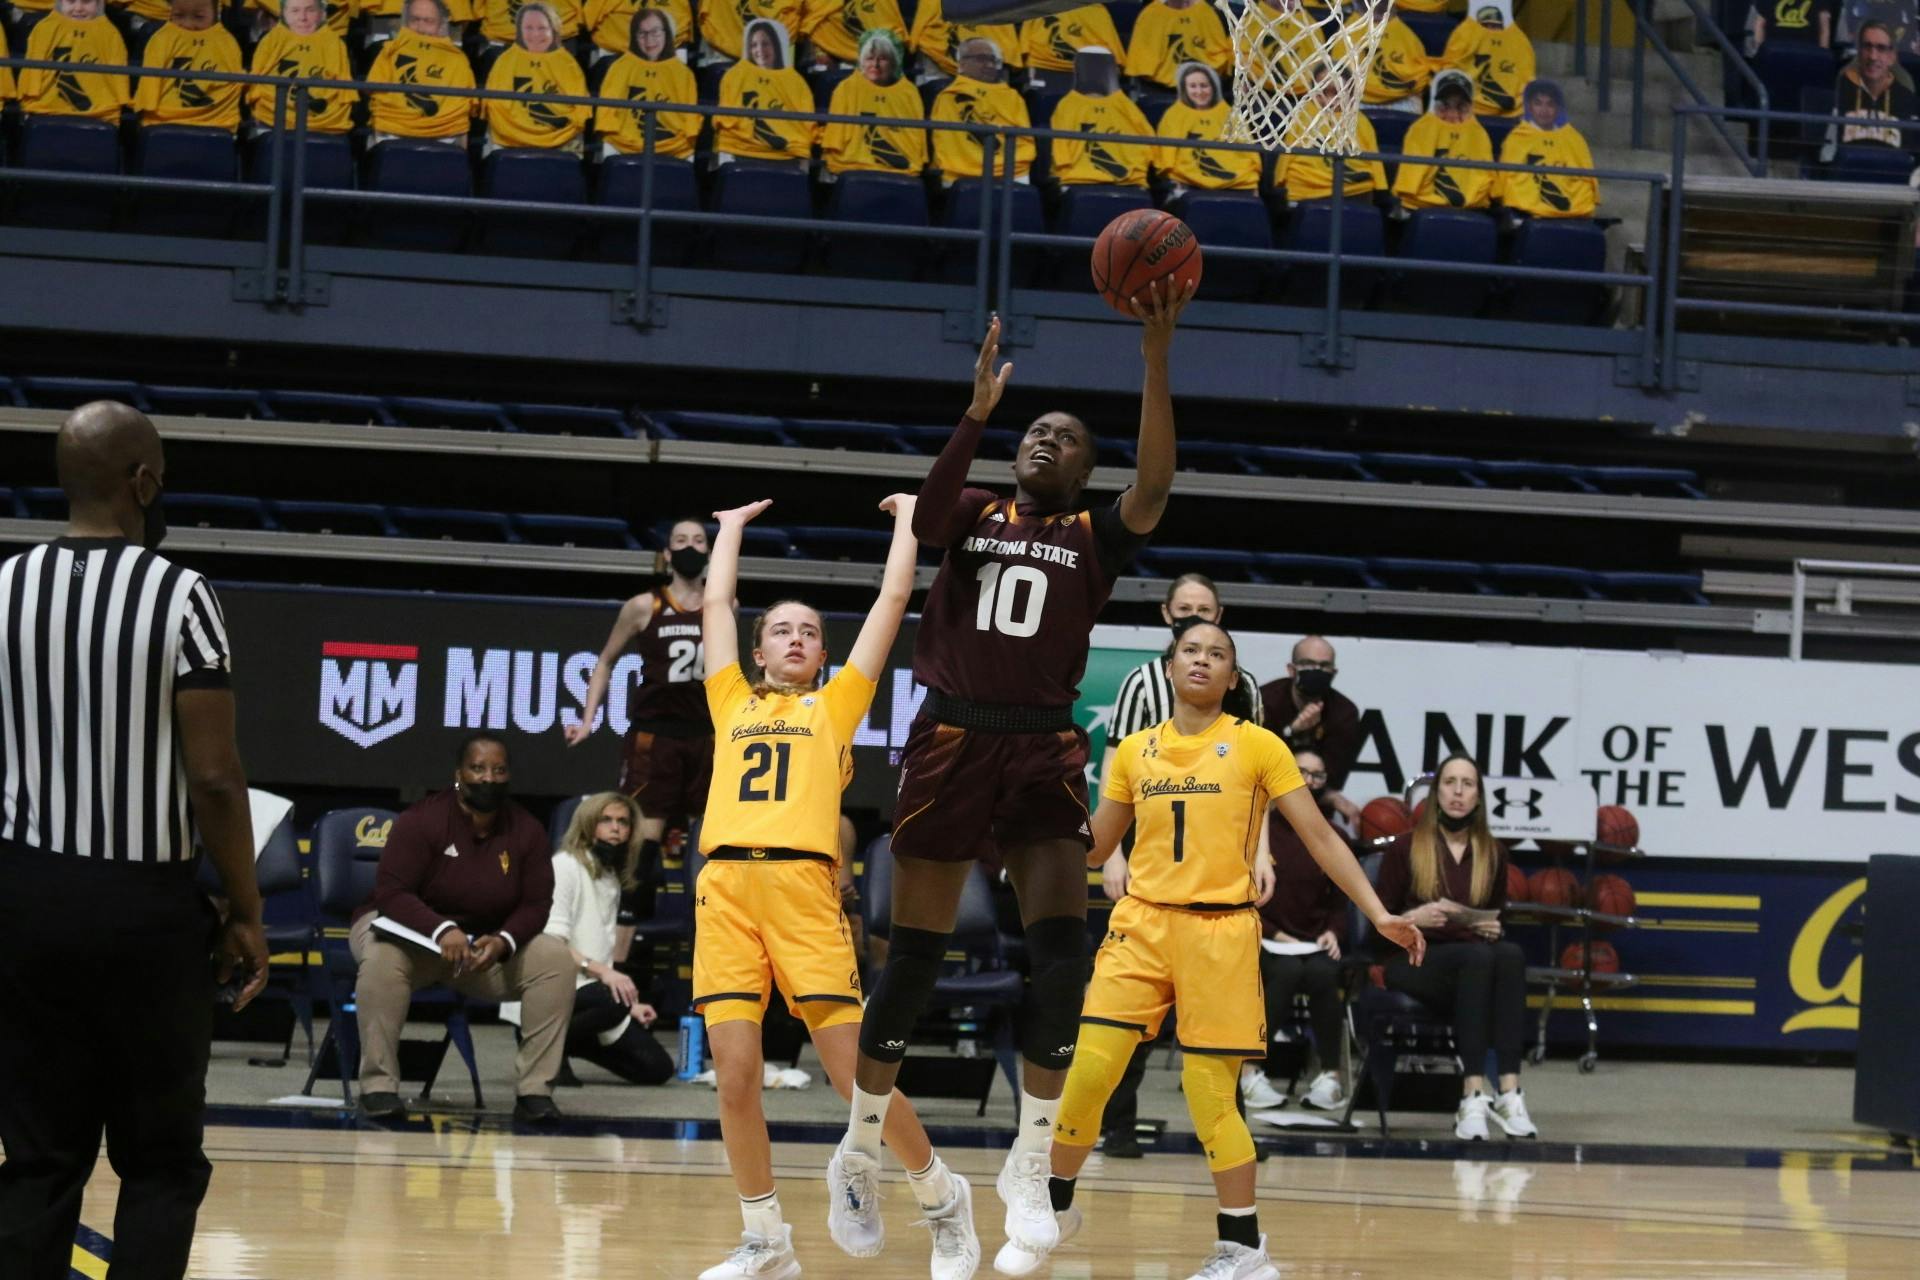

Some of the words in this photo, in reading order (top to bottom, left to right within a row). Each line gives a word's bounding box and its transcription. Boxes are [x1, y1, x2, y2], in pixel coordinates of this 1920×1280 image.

[1775, 0, 1812, 28] Cal
[426, 64, 444, 79] Cal
[962, 536, 1027, 555] ARIZONA
[1030, 541, 1079, 569] STATE
[976, 561, 1048, 637] 10
[658, 624, 701, 638] ARIZONA
[444, 647, 644, 738] MUSC
[731, 721, 769, 742] Golden
[771, 720, 814, 736] Bears
[1340, 708, 1571, 794] ANK
[1602, 725, 1672, 763] OF
[738, 742, 791, 802] 21
[1141, 778, 1180, 800] Golden
[1182, 776, 1221, 793] Bears
[1580, 769, 1686, 808] THE
[356, 815, 393, 847] Cal
[1171, 800, 1185, 863] 1
